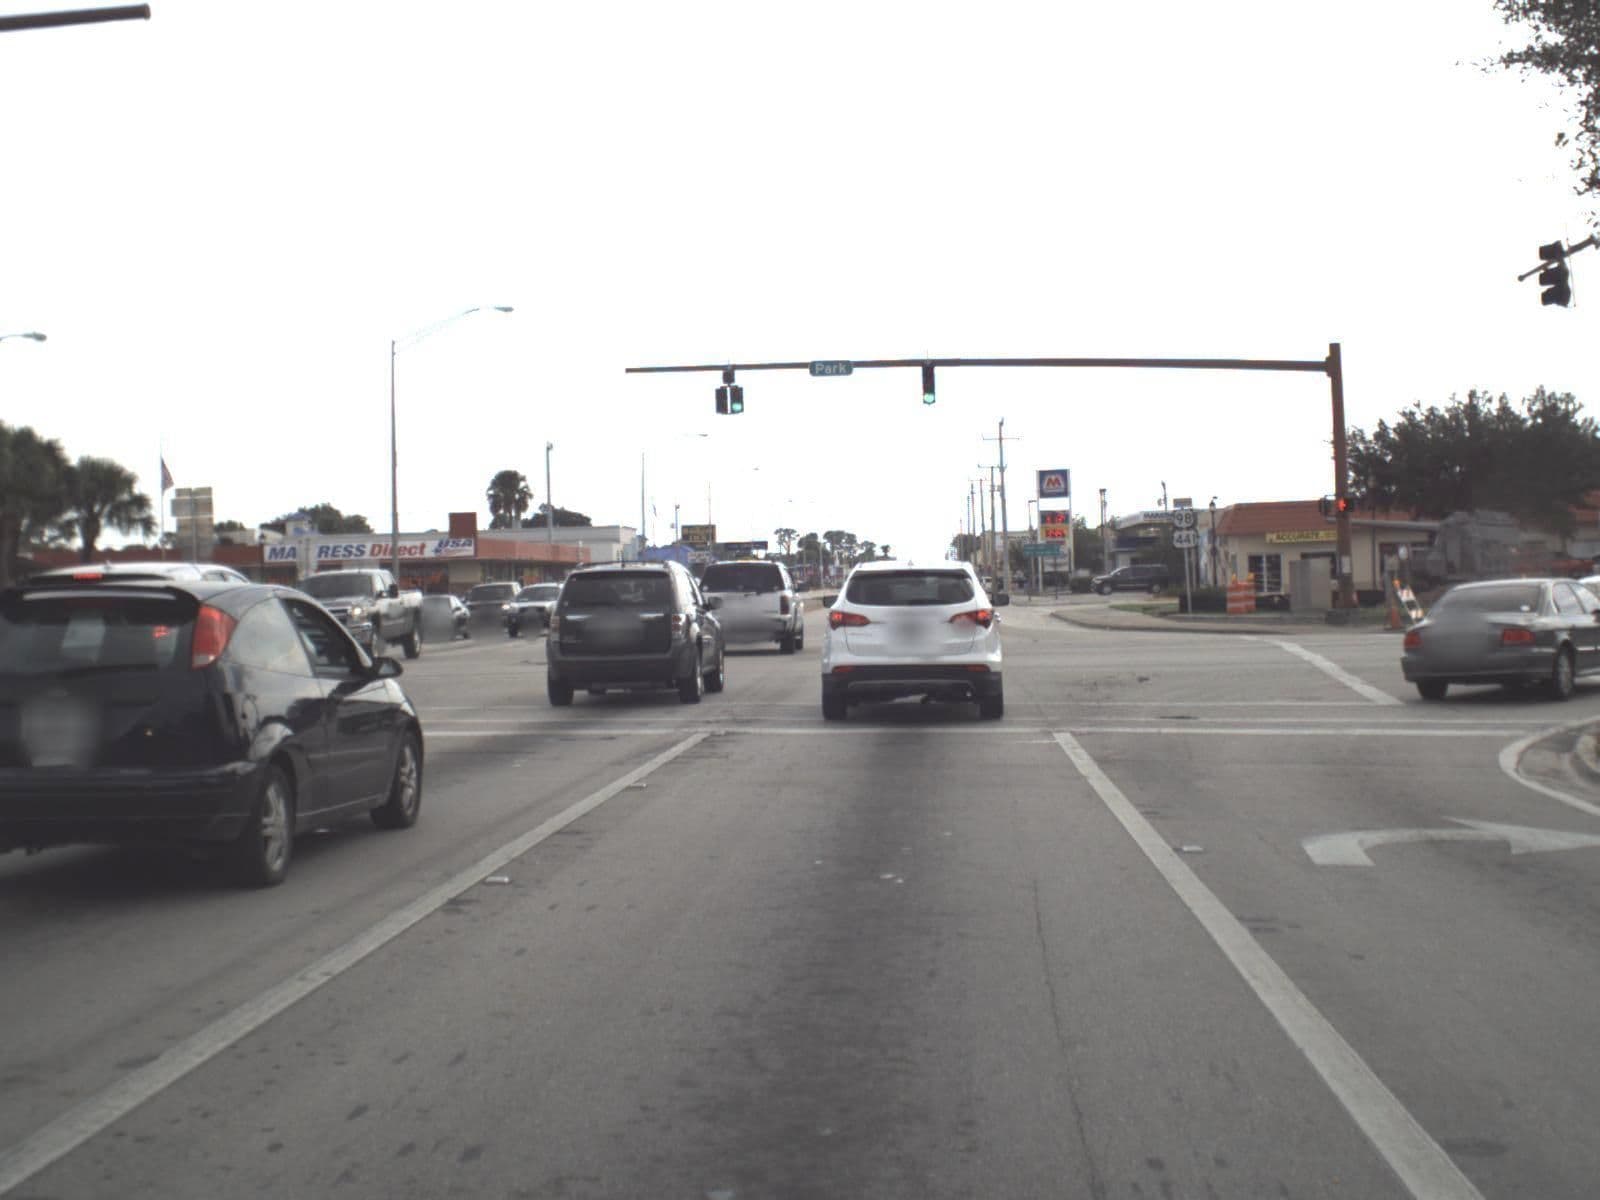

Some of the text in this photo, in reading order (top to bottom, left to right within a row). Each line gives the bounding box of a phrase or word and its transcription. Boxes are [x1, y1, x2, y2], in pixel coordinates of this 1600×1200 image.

[815, 362, 846, 374] Park
[1176, 512, 1192, 525] 98
[1176, 534, 1195, 544] 441
[268, 543, 366, 560] MARESS
[370, 542, 426, 557] Diect
